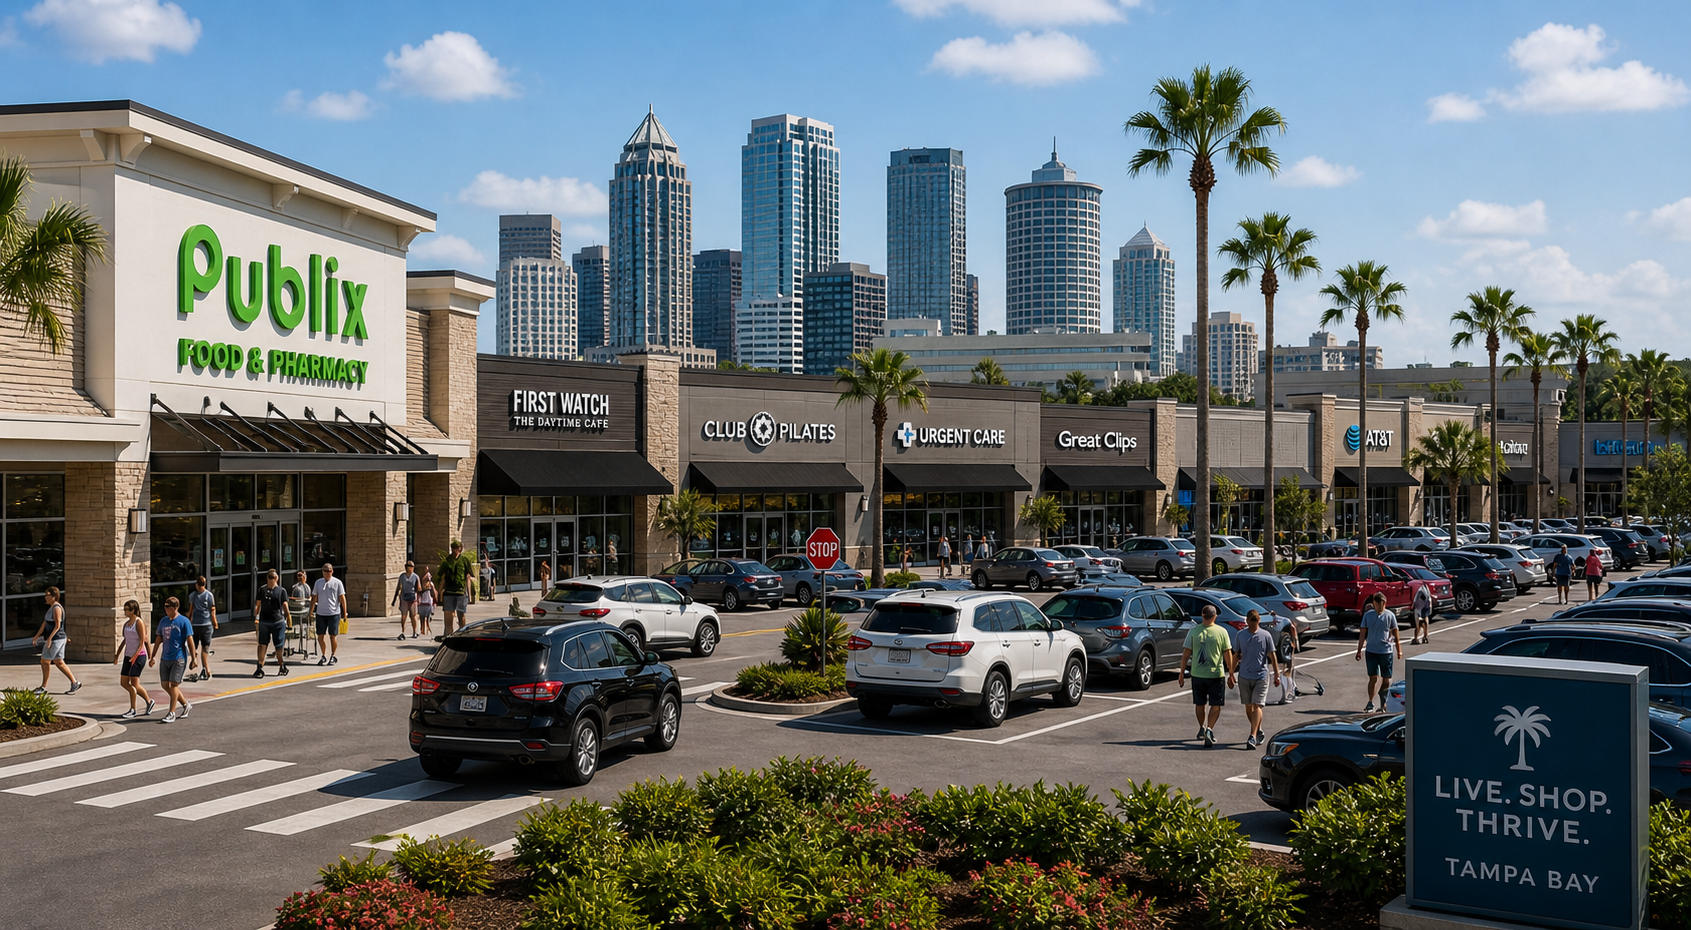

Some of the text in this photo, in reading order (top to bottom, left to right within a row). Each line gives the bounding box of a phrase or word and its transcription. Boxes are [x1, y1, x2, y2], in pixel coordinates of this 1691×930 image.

[179, 224, 369, 339] Publix
[179, 338, 369, 384] FOOD & PHARMACY
[513, 390, 610, 416] FIRST WATCH
[513, 416, 609, 429] THE DAYTIME CAFE
[704, 420, 836, 440] CLUB PILATES
[919, 428, 1006, 445] URGENT CARE
[1058, 431, 1137, 452] Great Clips
[1366, 430, 1394, 446] AT&T
[809, 542, 838, 557] STOP
[1435, 775, 1612, 815] LIVE. SHOP.
[1456, 808, 1590, 845] THRIVE.
[1445, 857, 1600, 894] TAMPA BAY
